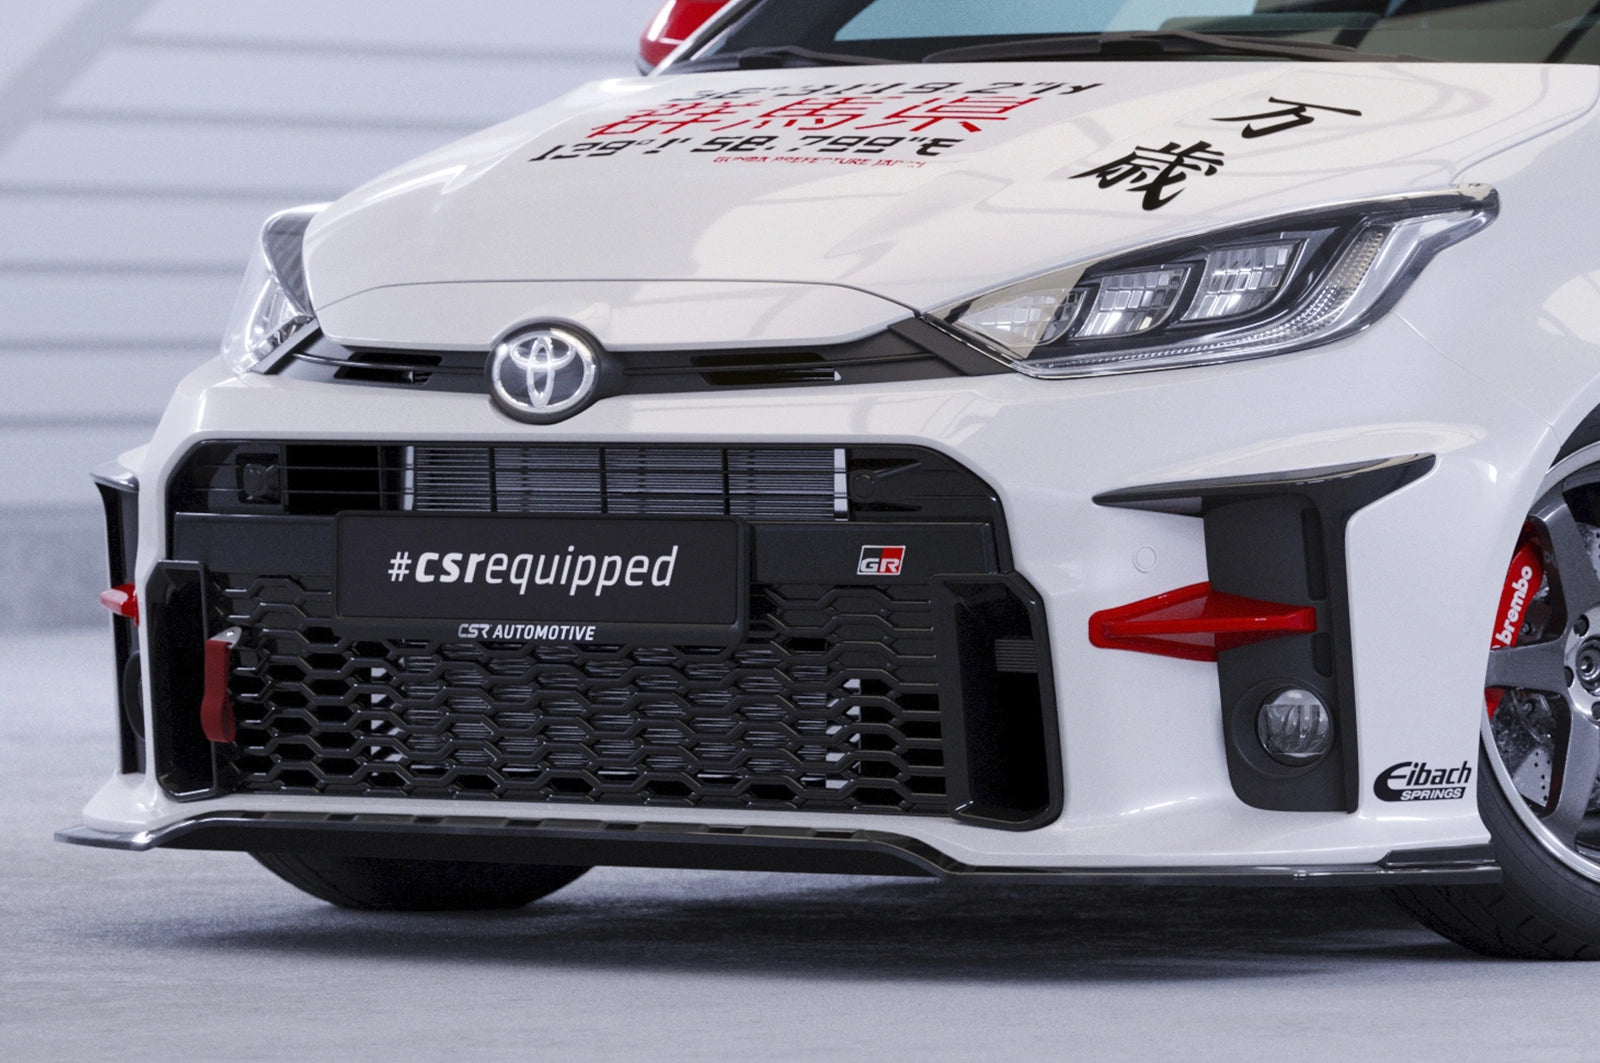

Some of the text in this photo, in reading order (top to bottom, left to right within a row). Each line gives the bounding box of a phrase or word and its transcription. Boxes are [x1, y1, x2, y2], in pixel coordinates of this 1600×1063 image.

[586, 96, 1041, 138] 群馬県
[388, 544, 679, 596] #csrequipped
[861, 558, 899, 573] GR
[1495, 565, 1533, 646] brembo
[458, 623, 596, 640] CSR AUTOMOTIVE
[1373, 760, 1472, 802] Eibach
[1400, 788, 1463, 801] SPRINGS
